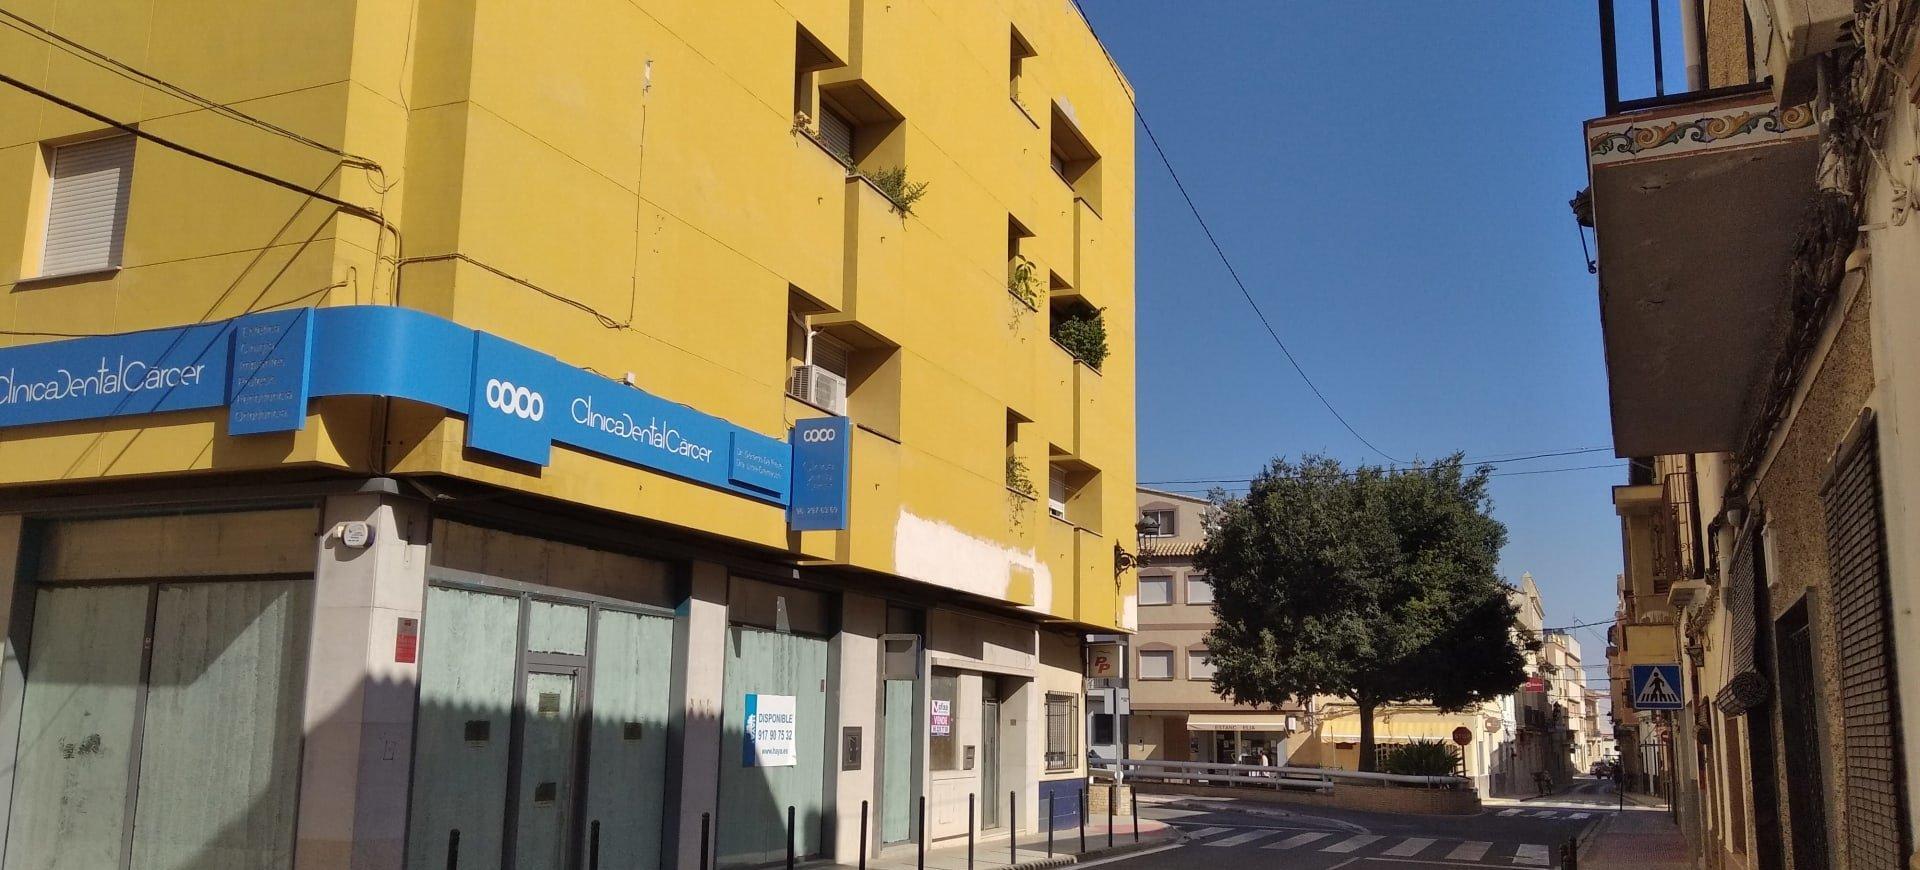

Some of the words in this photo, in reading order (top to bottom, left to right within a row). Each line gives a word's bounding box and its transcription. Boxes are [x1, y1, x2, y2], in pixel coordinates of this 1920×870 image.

[758, 713, 793, 723] DISPONIBLE
[758, 729, 769, 741] 917
[770, 729, 777, 741] 90
[778, 729, 785, 741] 75
[785, 730, 793, 741] 32
[762, 747, 789, 756] www.haya.es
